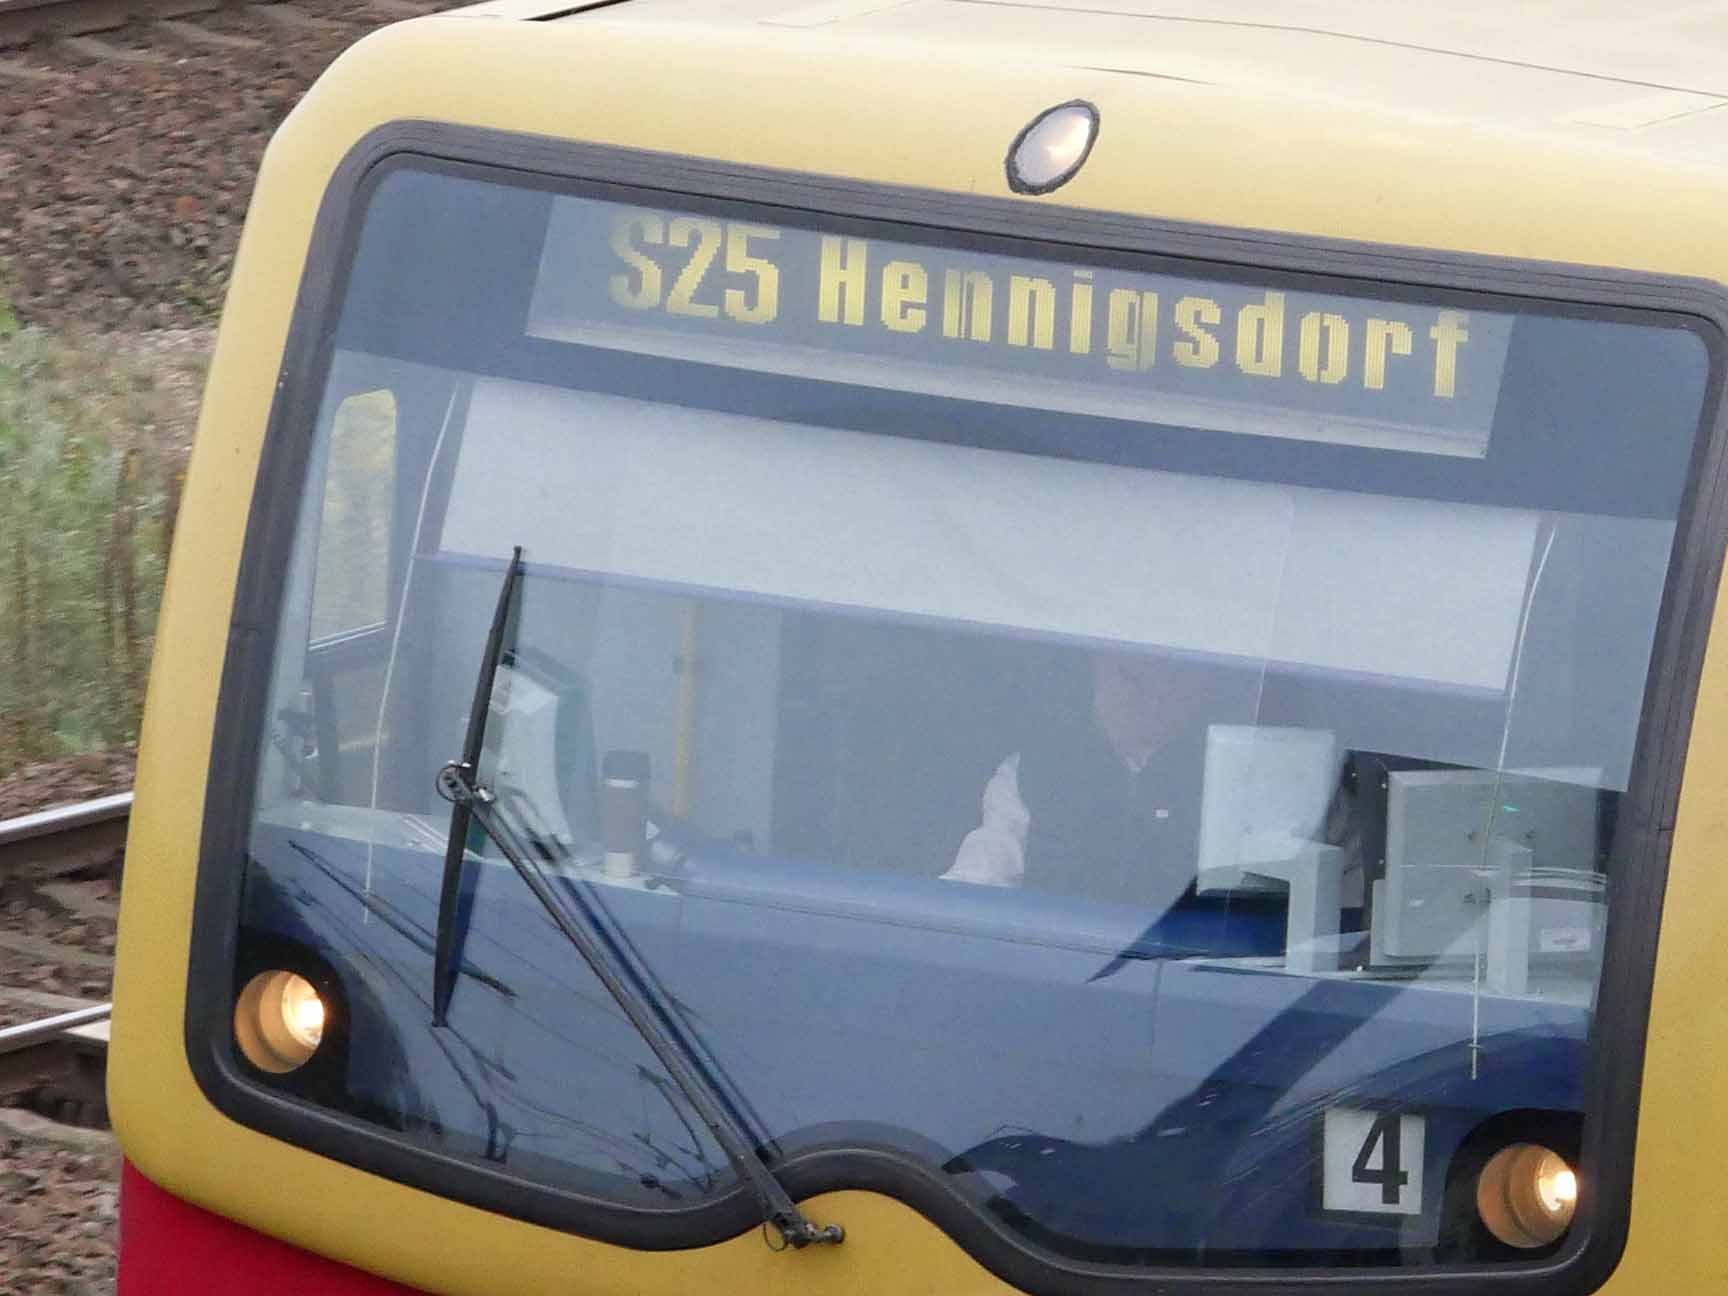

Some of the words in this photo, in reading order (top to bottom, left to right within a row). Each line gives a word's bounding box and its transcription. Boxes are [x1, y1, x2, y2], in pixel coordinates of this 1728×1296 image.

[609, 215, 780, 324] S25
[816, 236, 1470, 400] Hennigsdorf
[1351, 1109, 1409, 1205] 4
